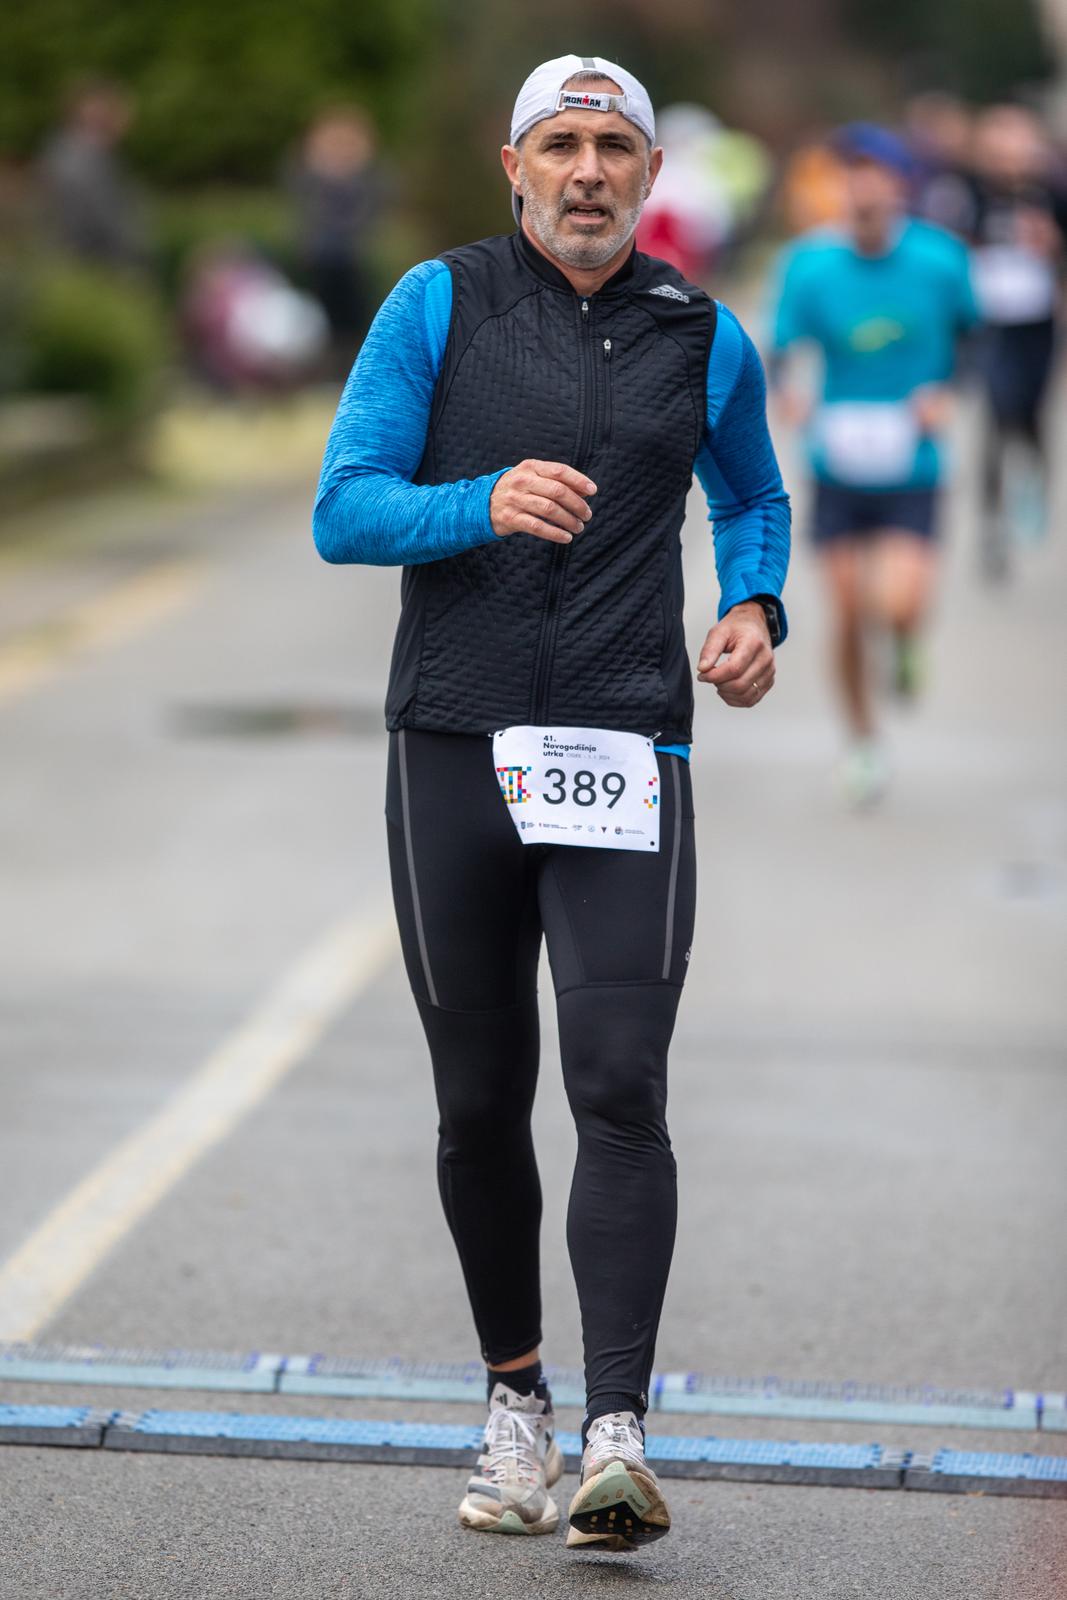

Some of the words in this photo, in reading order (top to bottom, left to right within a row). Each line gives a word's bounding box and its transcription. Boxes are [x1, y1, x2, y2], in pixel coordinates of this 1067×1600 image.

[563, 95, 601, 107] IRONMAN
[543, 742, 597, 752] Novogodišnja
[543, 768, 626, 810] 389
